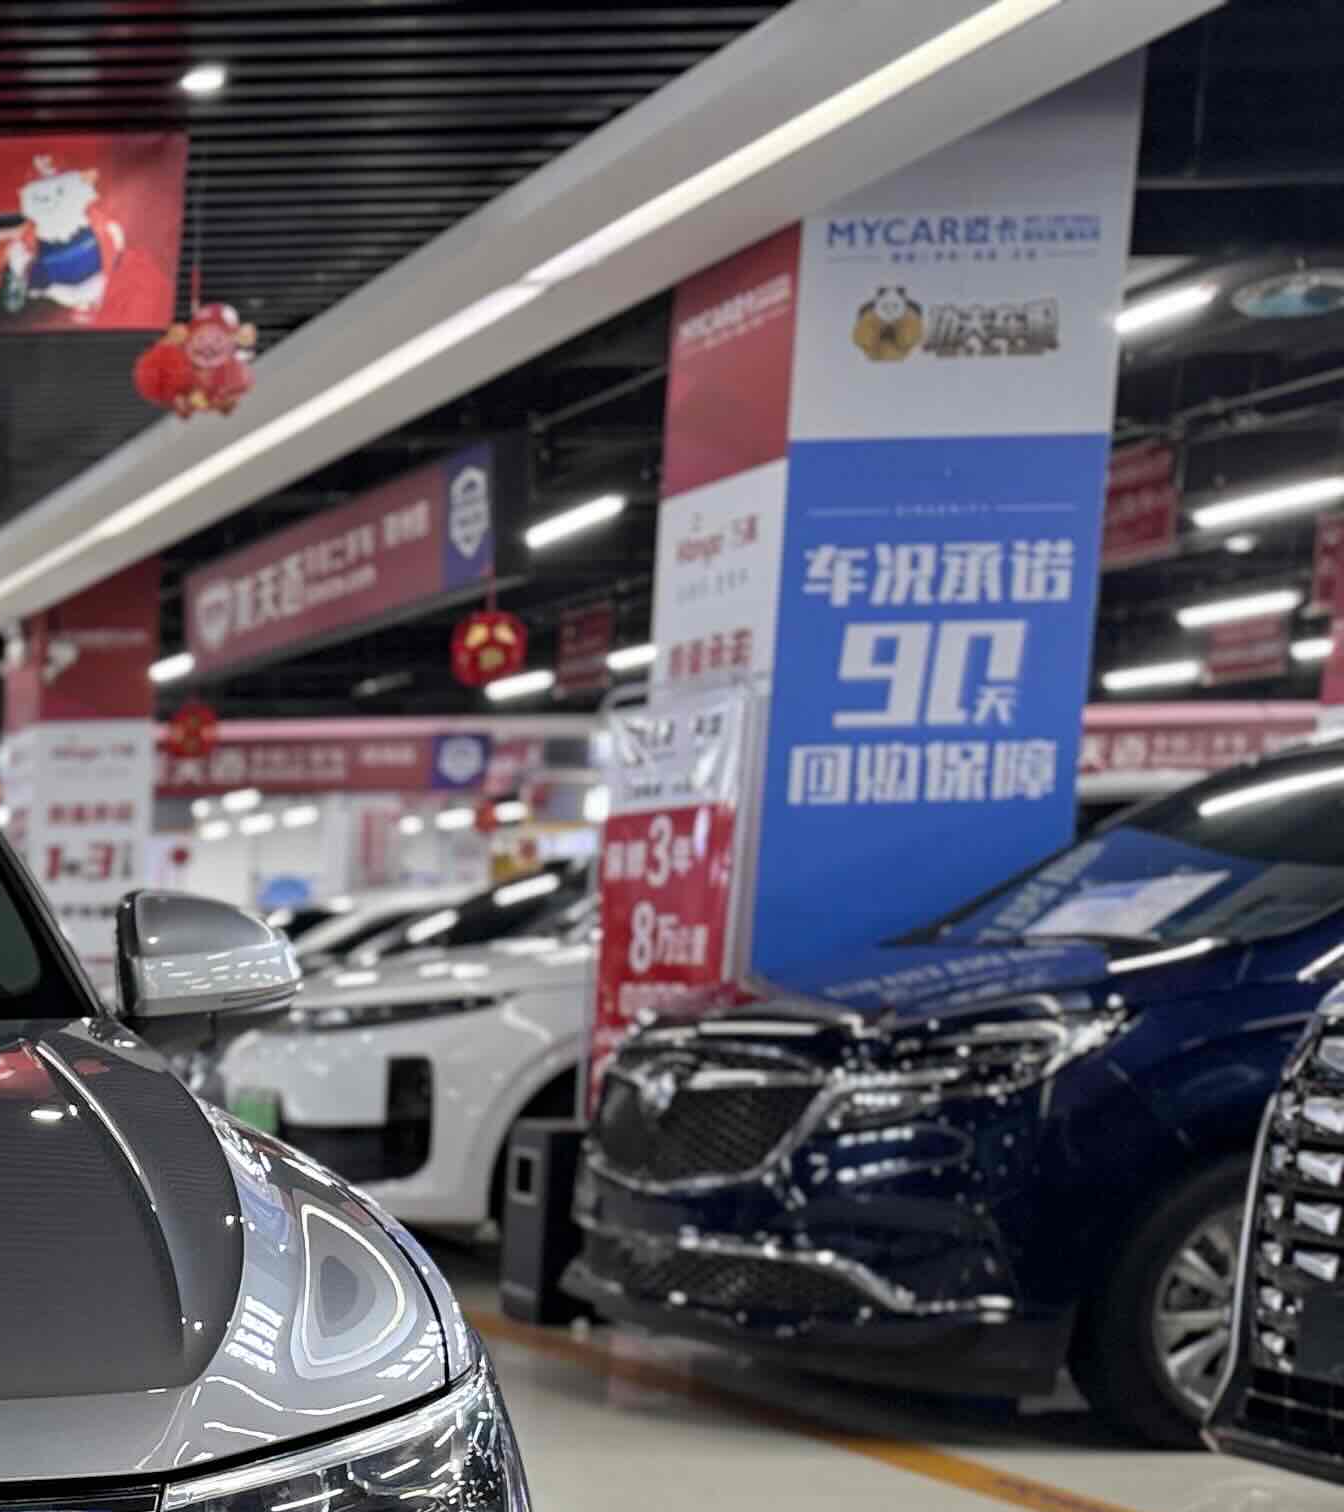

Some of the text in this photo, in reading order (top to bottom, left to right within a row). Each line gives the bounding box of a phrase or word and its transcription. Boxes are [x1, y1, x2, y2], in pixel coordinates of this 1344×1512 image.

[802, 538, 1073, 607] 车况承诺
[787, 738, 1058, 807] 回购保障
